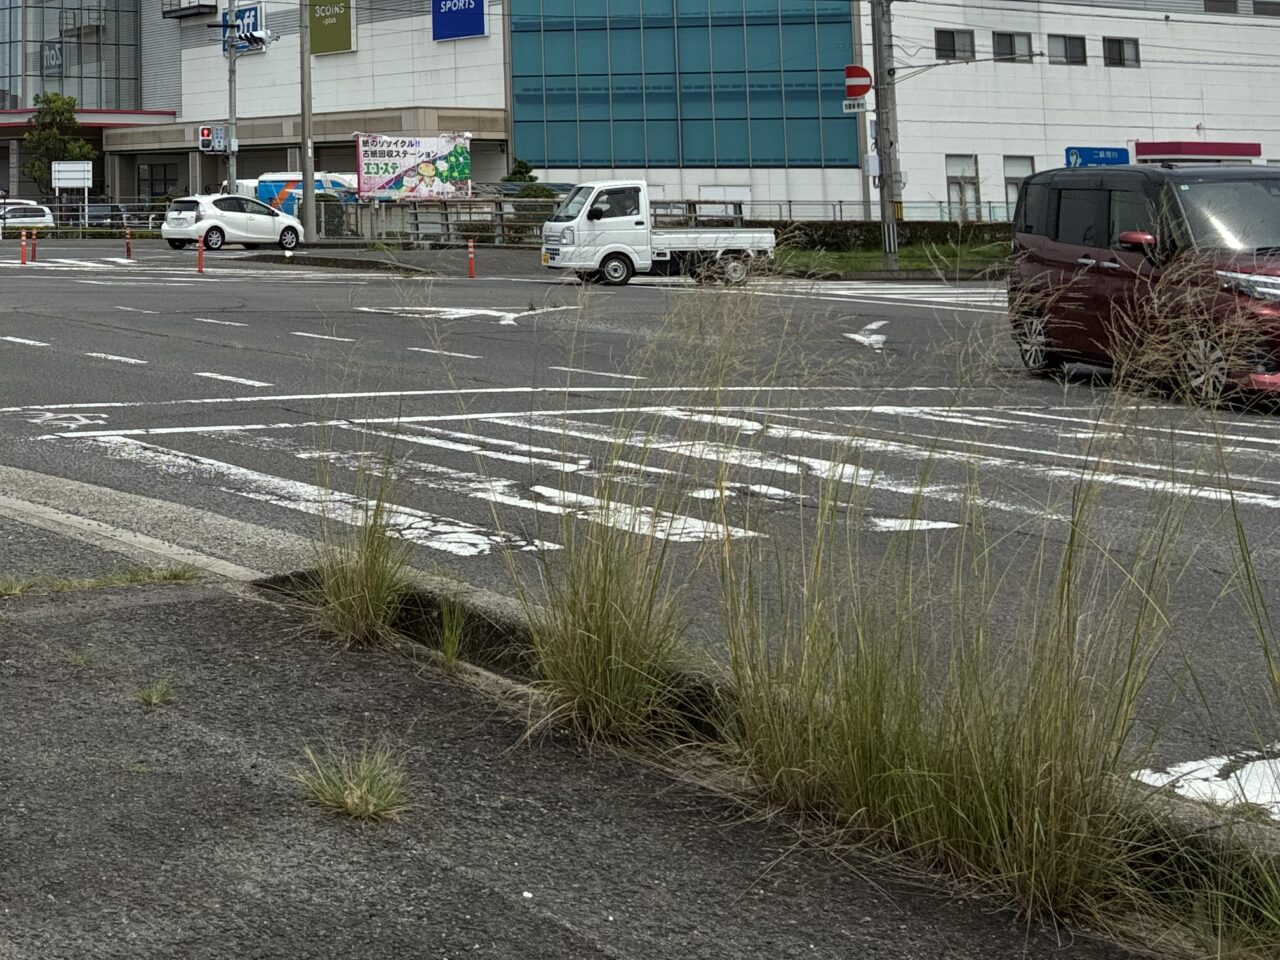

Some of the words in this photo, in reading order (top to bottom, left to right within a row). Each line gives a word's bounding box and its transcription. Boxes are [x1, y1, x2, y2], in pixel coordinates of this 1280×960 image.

[362, 149, 439, 159] 古紙回収ステーション
